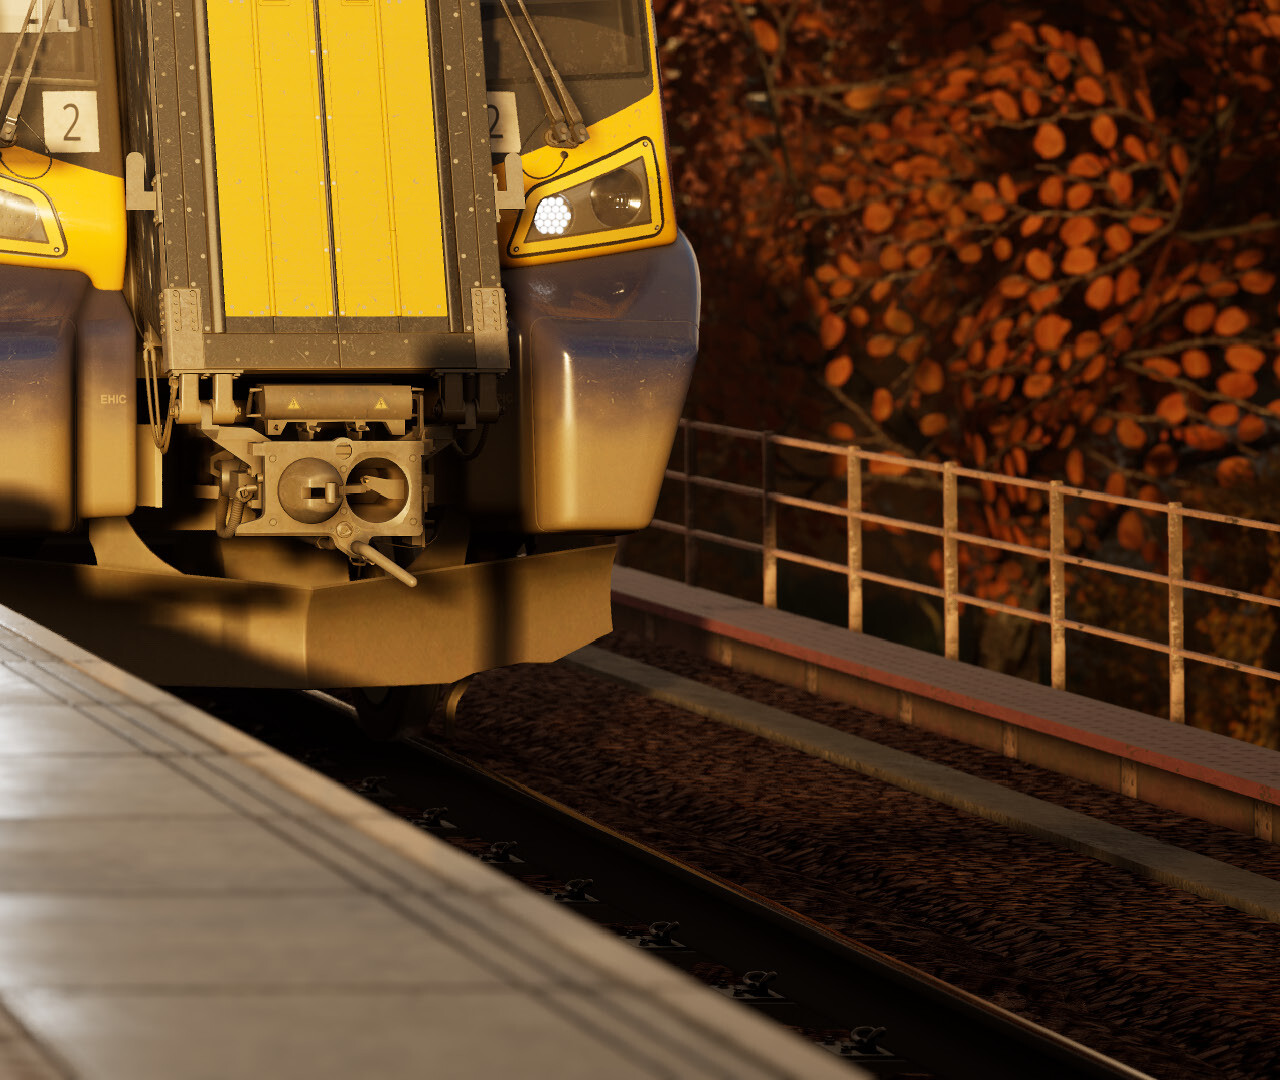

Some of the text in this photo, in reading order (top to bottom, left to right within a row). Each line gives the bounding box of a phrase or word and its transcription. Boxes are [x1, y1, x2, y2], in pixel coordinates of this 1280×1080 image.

[62, 103, 82, 142] 2
[487, 104, 504, 139] 2
[100, 394, 127, 405] EHIC
